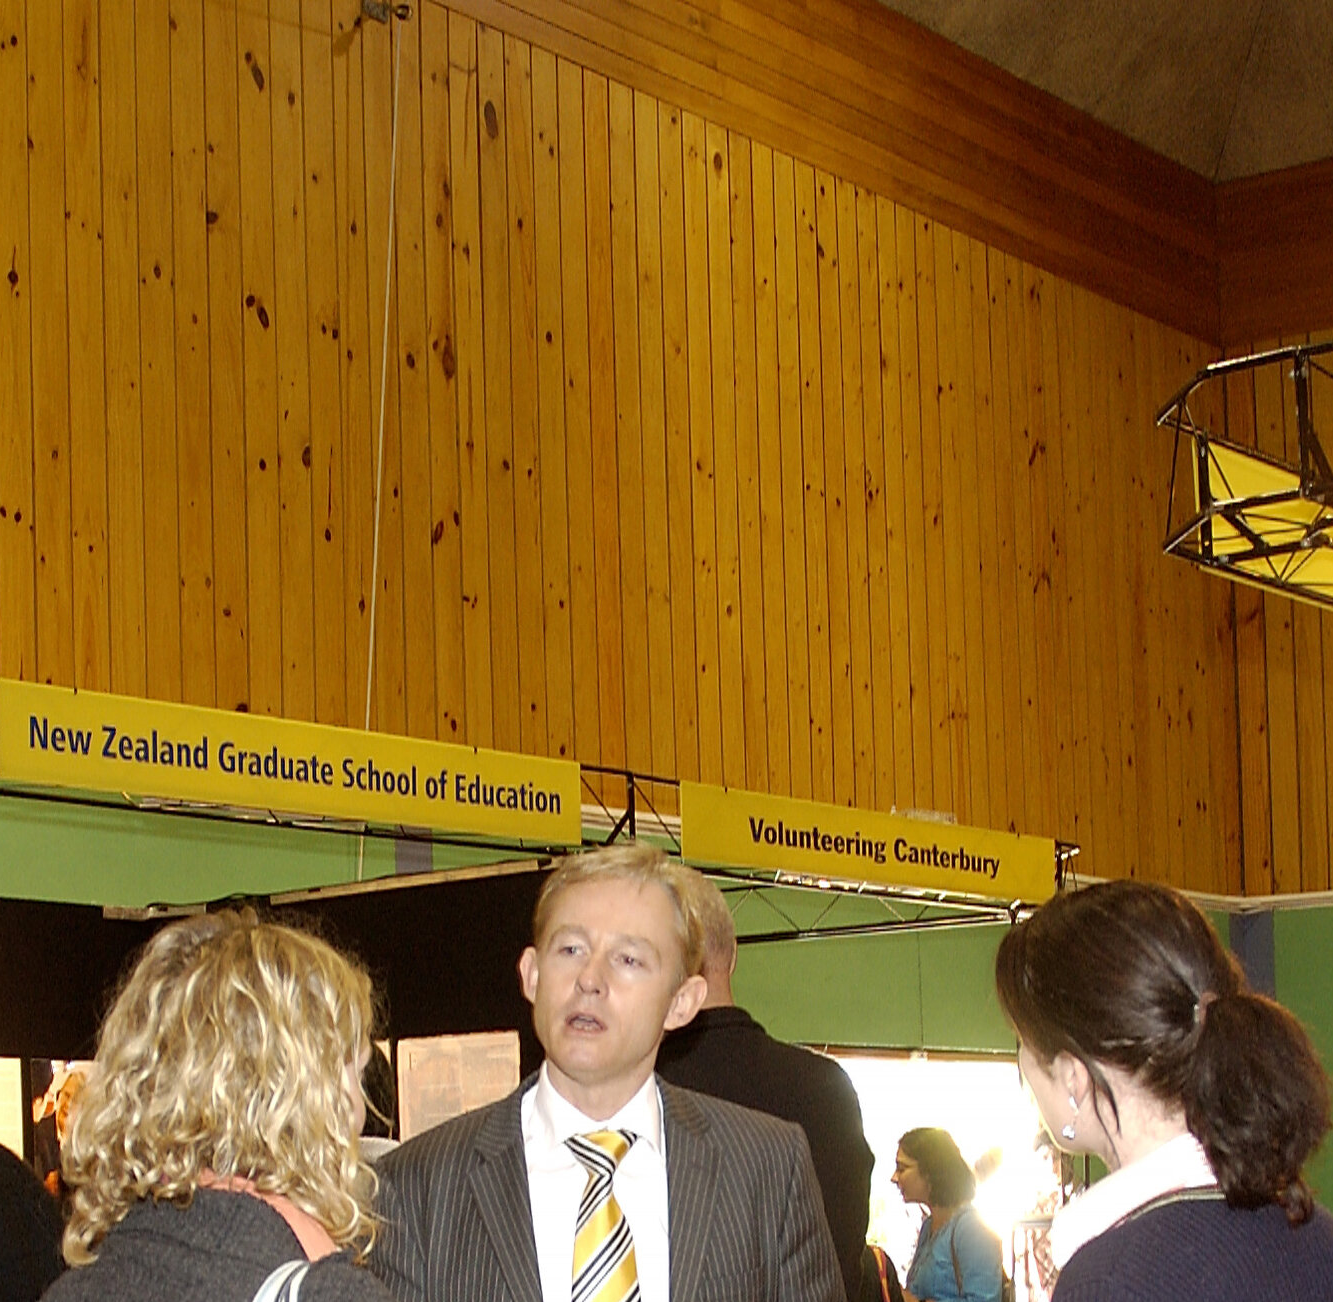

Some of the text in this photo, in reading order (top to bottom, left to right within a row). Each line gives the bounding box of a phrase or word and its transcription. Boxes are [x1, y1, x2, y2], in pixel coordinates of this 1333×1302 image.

[28, 715, 561, 815] New Zealand Graduate School of Education
[749, 817, 1000, 879] Volunteering Canterbury
